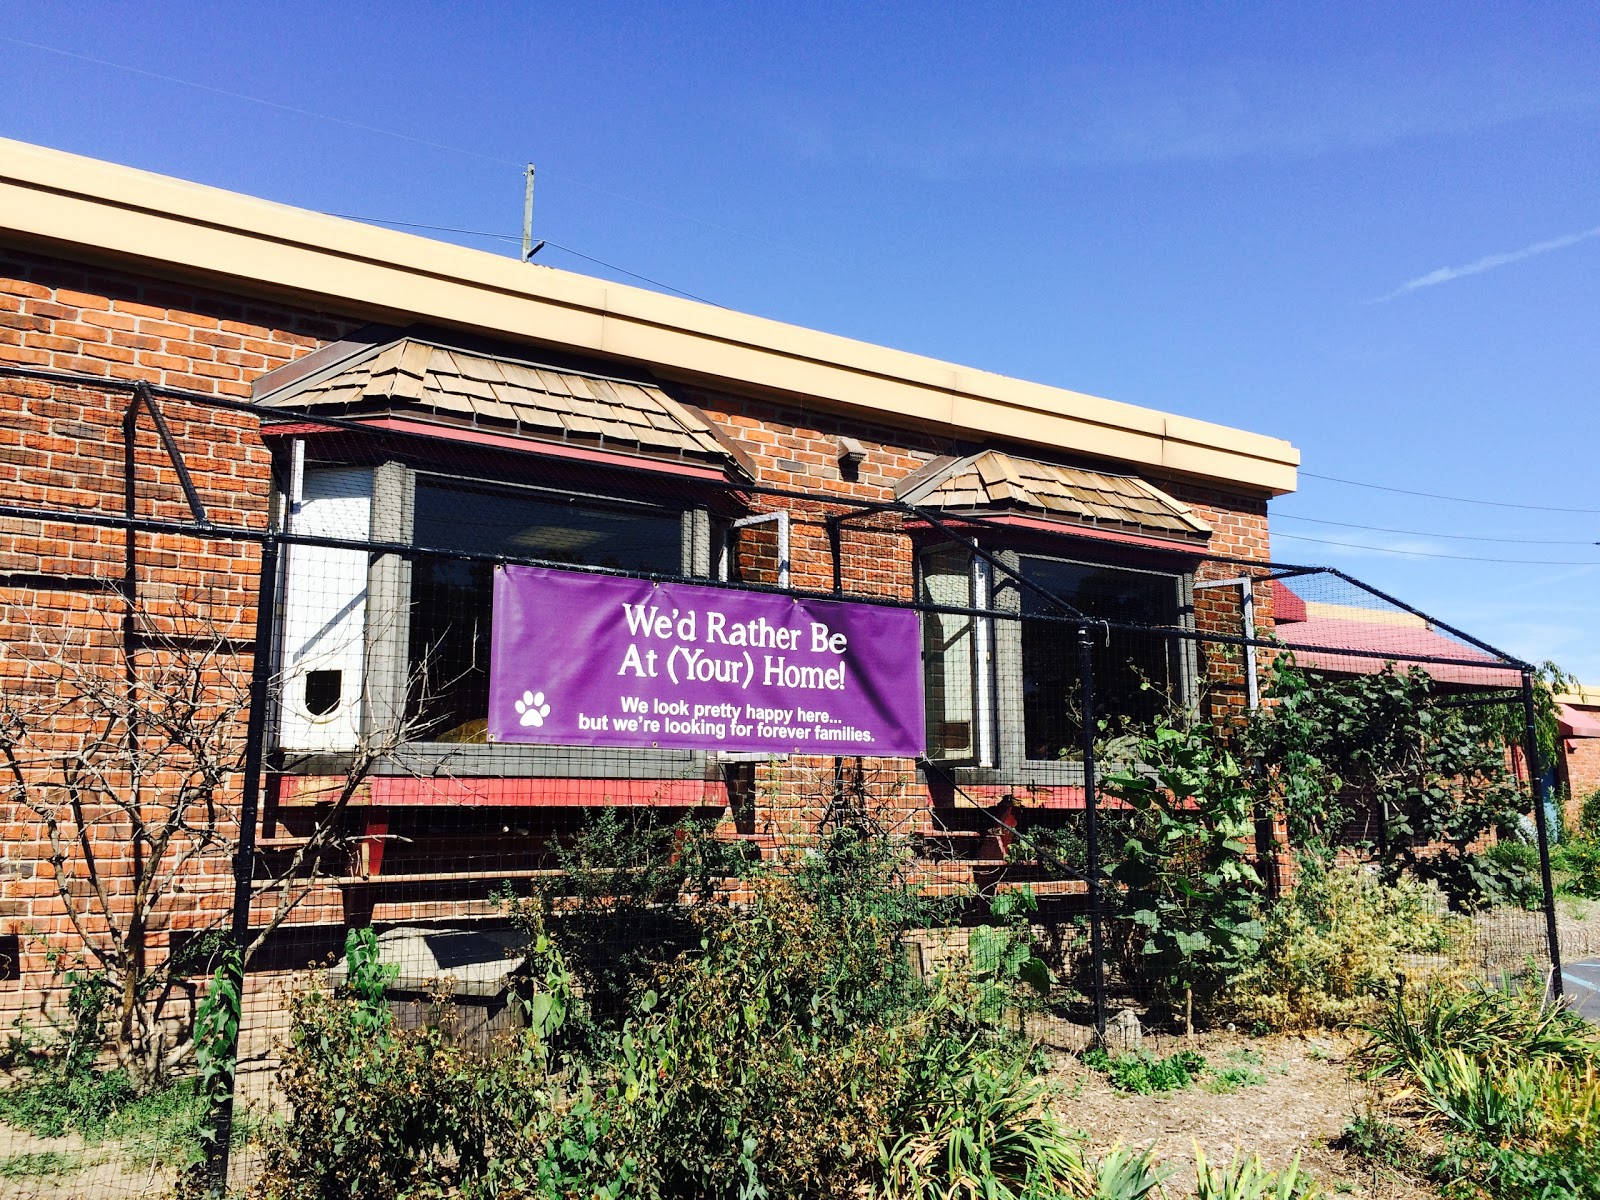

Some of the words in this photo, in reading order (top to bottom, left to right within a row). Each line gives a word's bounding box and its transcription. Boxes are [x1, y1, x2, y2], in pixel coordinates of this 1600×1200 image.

[622, 603, 697, 642] We'd
[706, 612, 802, 650] Rather
[810, 622, 847, 654] Be
[617, 644, 658, 677] At
[667, 645, 754, 689] (Your)
[763, 655, 846, 690] Home!
[578, 713, 608, 730] but
[613, 716, 660, 733] we're
[665, 718, 726, 739] looking
[730, 719, 754, 737] for
[757, 722, 812, 740] forever
[814, 725, 875, 742] families.
[621, 696, 649, 713] We
[653, 698, 689, 716] look
[694, 701, 742, 721] pretty
[746, 704, 793, 725] happy
[797, 707, 842, 724] here...
